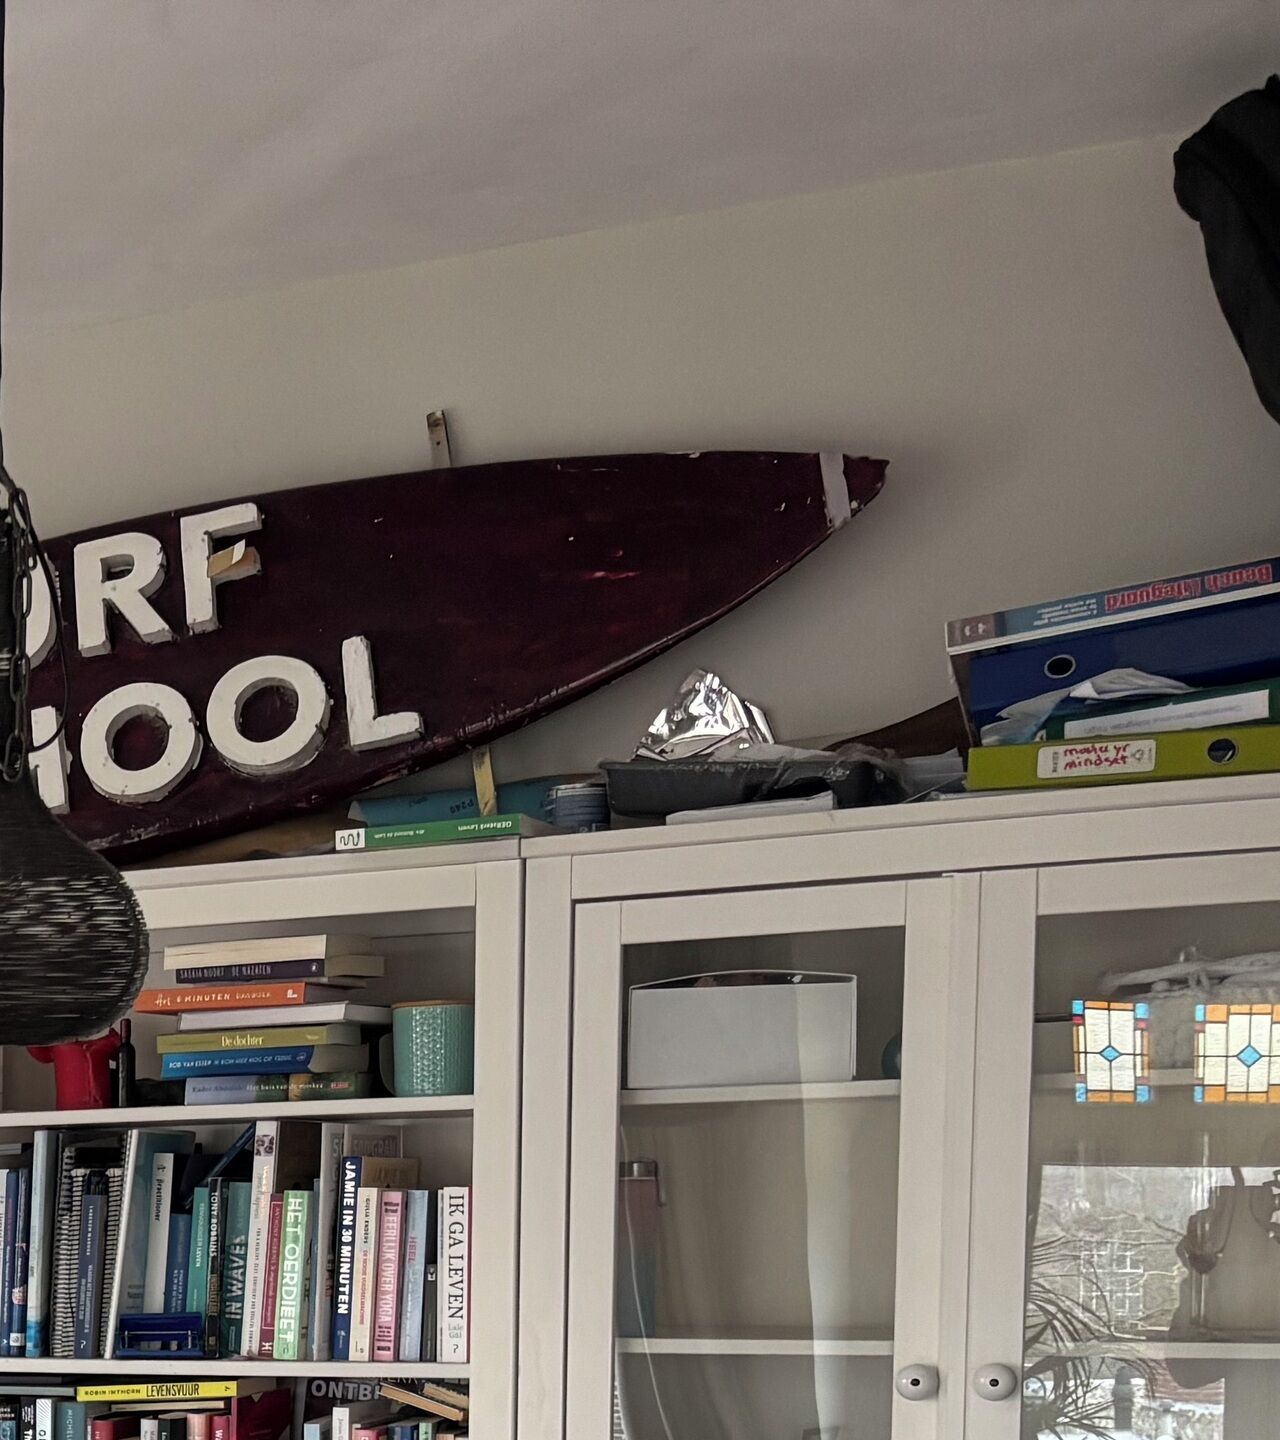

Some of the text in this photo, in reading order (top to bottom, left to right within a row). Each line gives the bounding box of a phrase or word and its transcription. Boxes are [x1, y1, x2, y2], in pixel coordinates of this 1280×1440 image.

[1205, 564, 1273, 592] Beach
[1064, 755, 1127, 770] mindset
[180, 965, 271, 978] SASKIA NOORT DE NAZATEN
[185, 993, 231, 1002] MINUTEN
[222, 1035, 263, 1047] De dochter
[210, 1192, 218, 1257] TONY ROBBINS
[338, 1161, 356, 1313] JAMIE IN 30 MINUTEN
[408, 1237, 417, 1264] HEEL
[448, 1194, 464, 1319] IK GA LEVEN
[225, 1235, 246, 1318] IN WAVES
[280, 1198, 302, 1342] HET OERDIEET
[380, 1216, 397, 1322] EERLIJK OVER YOGA
[146, 1382, 199, 1397] LEVENSVUUR
